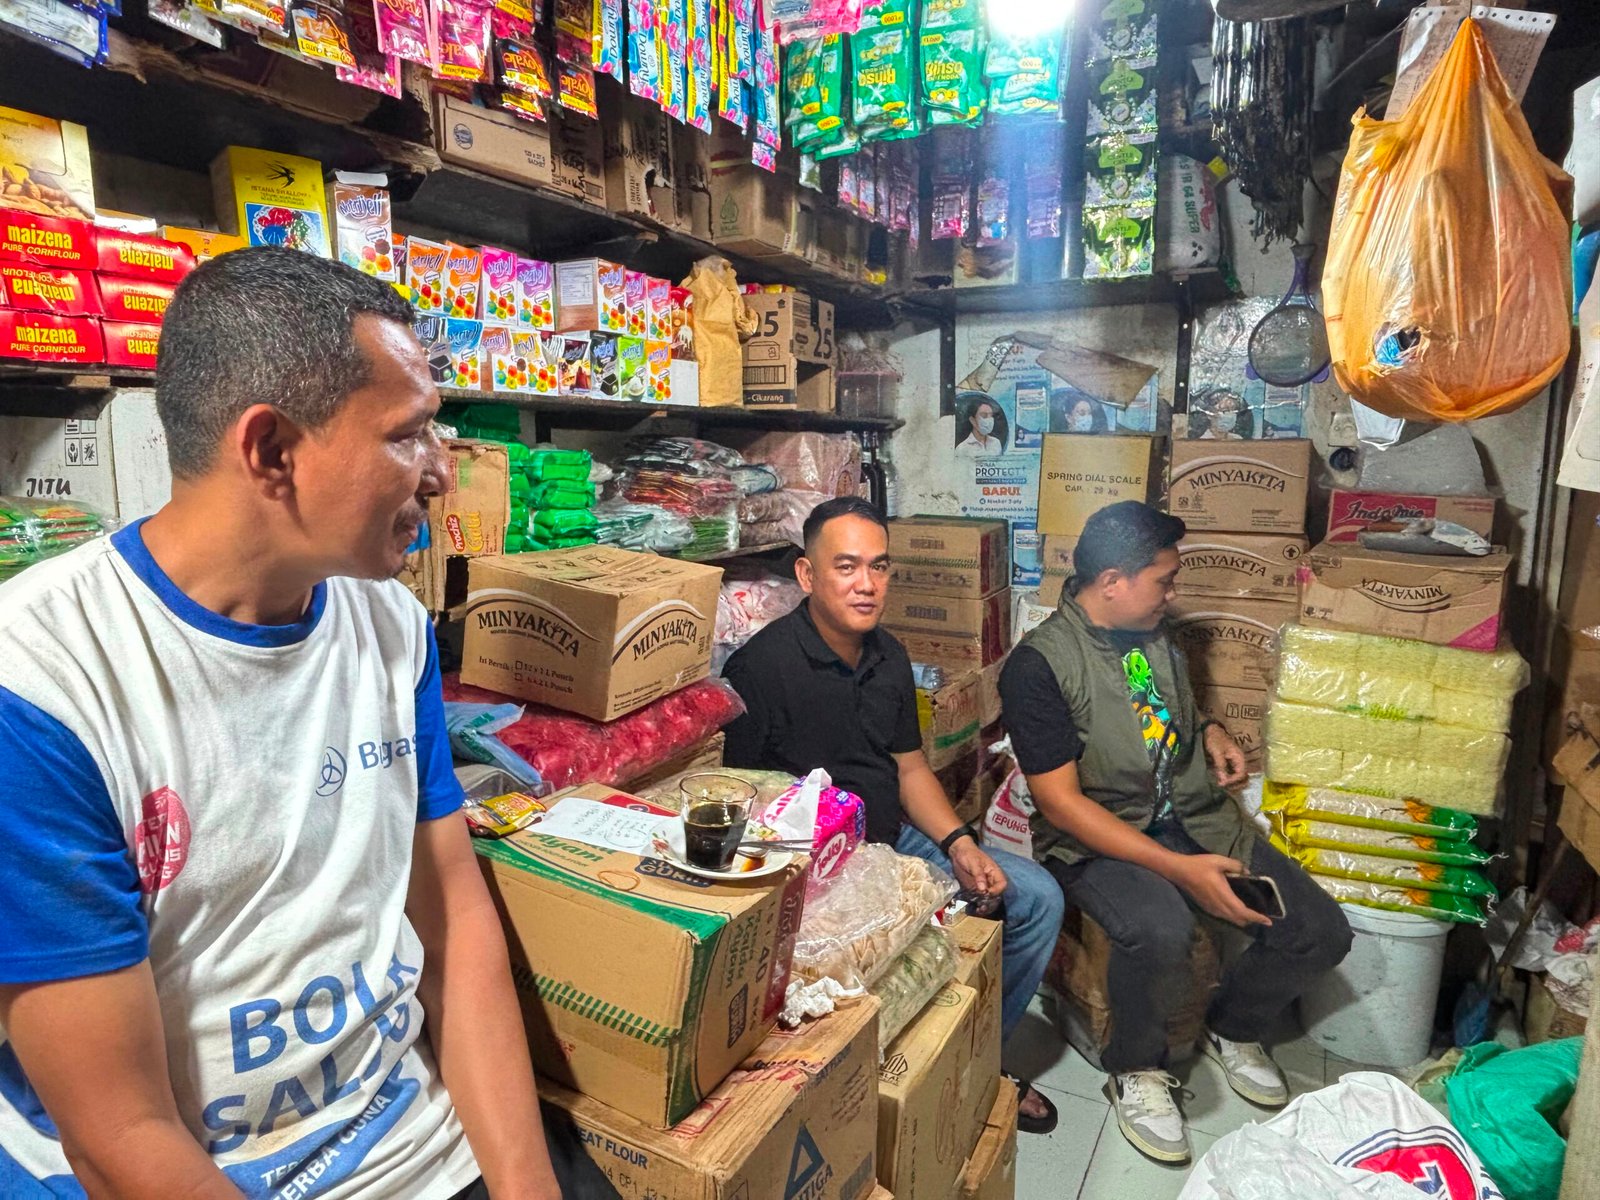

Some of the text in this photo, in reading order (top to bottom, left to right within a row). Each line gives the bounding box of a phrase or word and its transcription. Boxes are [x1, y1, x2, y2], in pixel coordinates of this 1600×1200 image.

[607, 5, 618, 59] Downy
[741, 21, 750, 66] Downy
[503, 49, 546, 80] Royale
[639, 33, 650, 82] Downy
[926, 62, 963, 75] Rinso
[561, 73, 594, 101] Royale
[672, 52, 682, 101] Downy
[858, 68, 896, 86] Rinso
[700, 68, 710, 112] Downy
[1184, 200, 1200, 233] SUPER
[7, 224, 73, 250] maizena
[2, 243, 81, 260] PURE CORNFLOUR
[119, 248, 174, 273] maizena
[12, 278, 75, 304] maizena
[16, 323, 77, 344] maizena
[813, 327, 832, 359] 25
[11, 343, 86, 353] PURE CORNFLOUR
[127, 339, 160, 355] zena
[751, 393, 784, 403] Cikarang
[26, 478, 72, 497] JITU
[1047, 472, 1142, 485] SPRING DIAL SCALE
[1190, 469, 1286, 493] MINYAKITA
[1338, 500, 1425, 522] Indomie
[447, 515, 464, 550] Prochiz
[1180, 555, 1267, 577] MINYAKITA
[1361, 578, 1444, 600] MINYAKITA
[477, 609, 580, 658] MINYAKITA
[632, 618, 697, 661] MINYAKITA
[528, 832, 603, 862] Ayam
[640, 863, 708, 885] GUR
[578, 1128, 648, 1169] EAT FLOUR
[272, 1146, 341, 1200] ERBA
